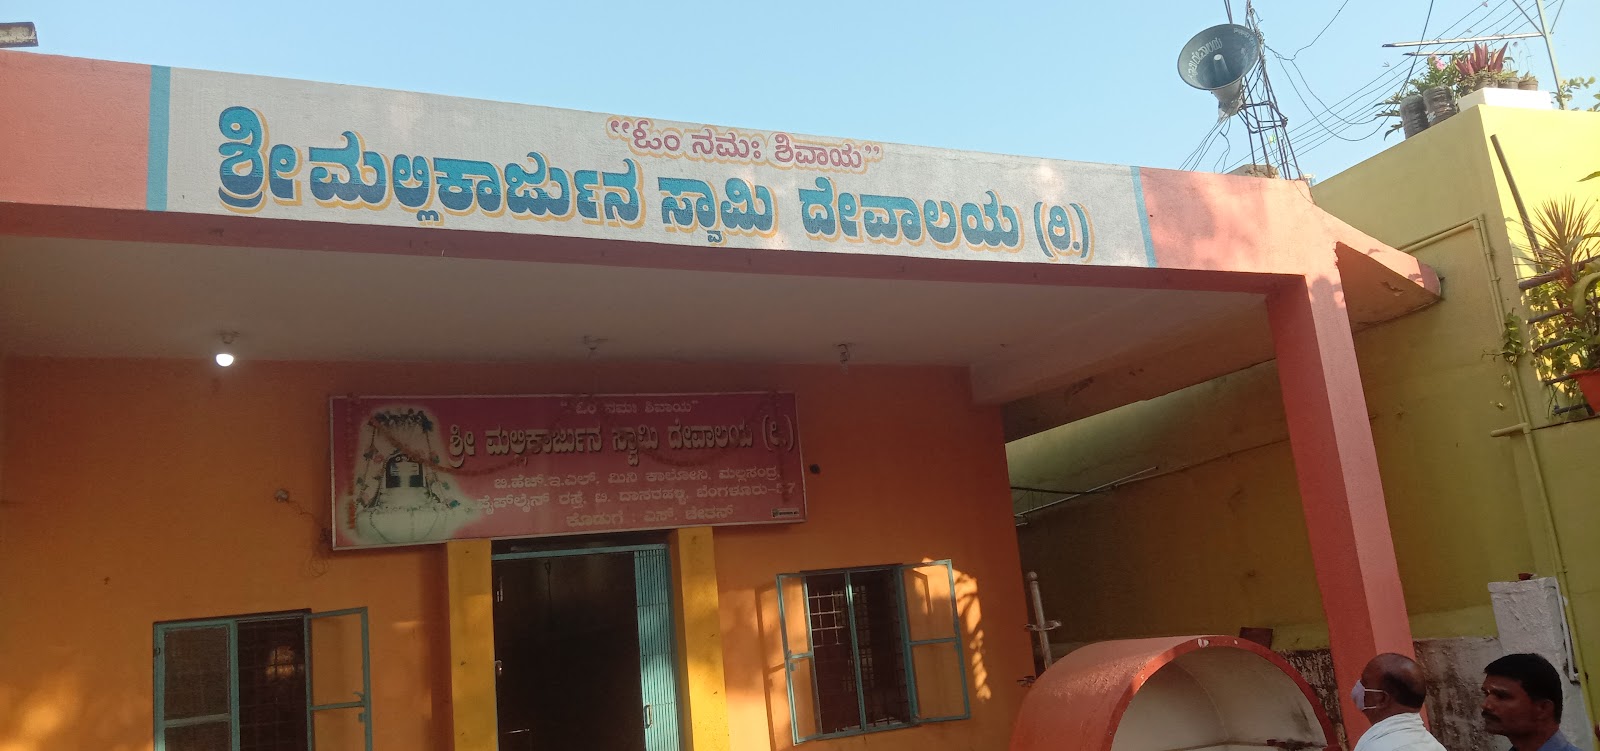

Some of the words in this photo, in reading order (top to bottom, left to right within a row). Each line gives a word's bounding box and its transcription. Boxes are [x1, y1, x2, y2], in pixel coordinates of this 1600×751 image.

[691, 128, 761, 159] ನಮಃ
[218, 105, 300, 210] ಶ್ರೀ
[307, 130, 645, 225] ಮಲ್ಲಿಕಾರ್ಜುನ
[657, 176, 776, 244] ಸ್ವಾಮಿ
[797, 176, 1021, 249] ದೇವಾಲಯ
[1033, 201, 1092, 260] (ರಿ.)
[605, 401, 638, 414] ನಮಃ
[449, 423, 476, 468] ಶ್ರೀ
[667, 418, 753, 449] ದೇವಾಲಯ
[607, 471, 638, 484] ಮಿನಿ
